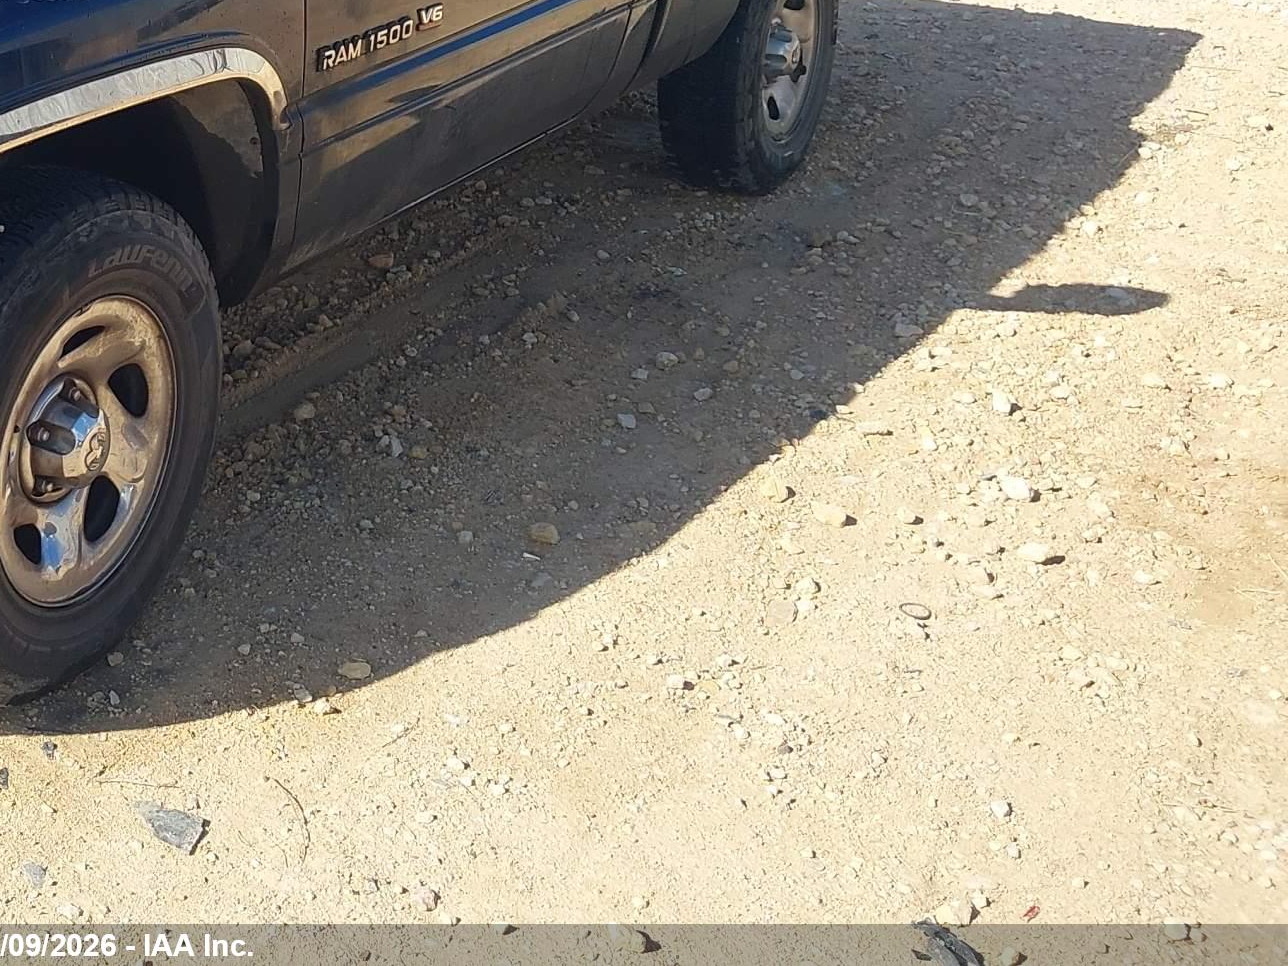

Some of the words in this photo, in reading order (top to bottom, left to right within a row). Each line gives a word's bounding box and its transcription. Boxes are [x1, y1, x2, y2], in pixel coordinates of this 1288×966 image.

[322, 38, 363, 71] RAM
[368, 18, 415, 53] 1500
[420, 4, 445, 25] V6
